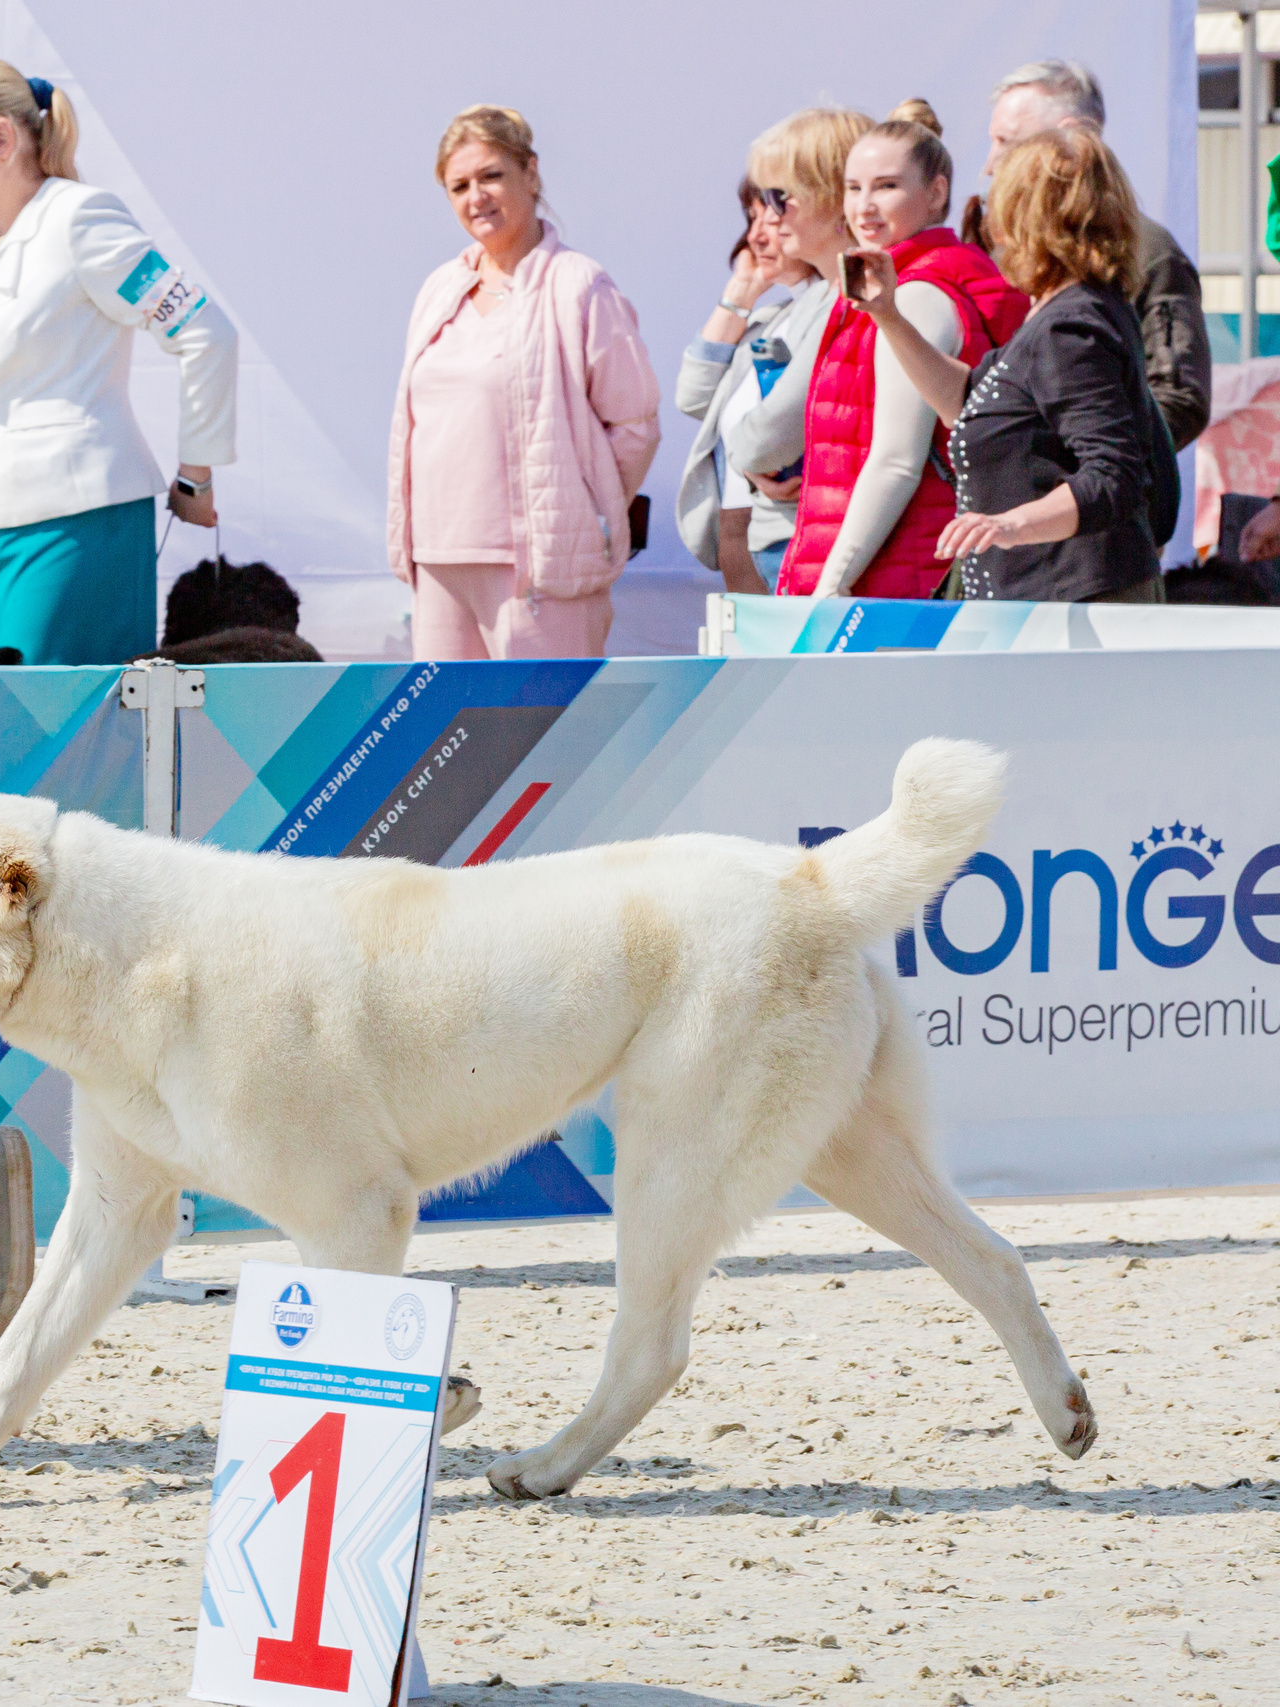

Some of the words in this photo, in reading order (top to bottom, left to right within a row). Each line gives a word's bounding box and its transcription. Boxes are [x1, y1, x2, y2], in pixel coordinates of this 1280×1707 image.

[304, 731, 384, 821] ПРЕЗИДЕНТА
[380, 697, 411, 732] РКФ
[407, 661, 441, 700] 2022
[361, 799, 409, 854] КУБОК
[406, 766, 434, 800] СНГ
[433, 727, 470, 769] 2022
[272, 1304, 314, 1326] Farmina
[254, 1411, 353, 1693] 1
